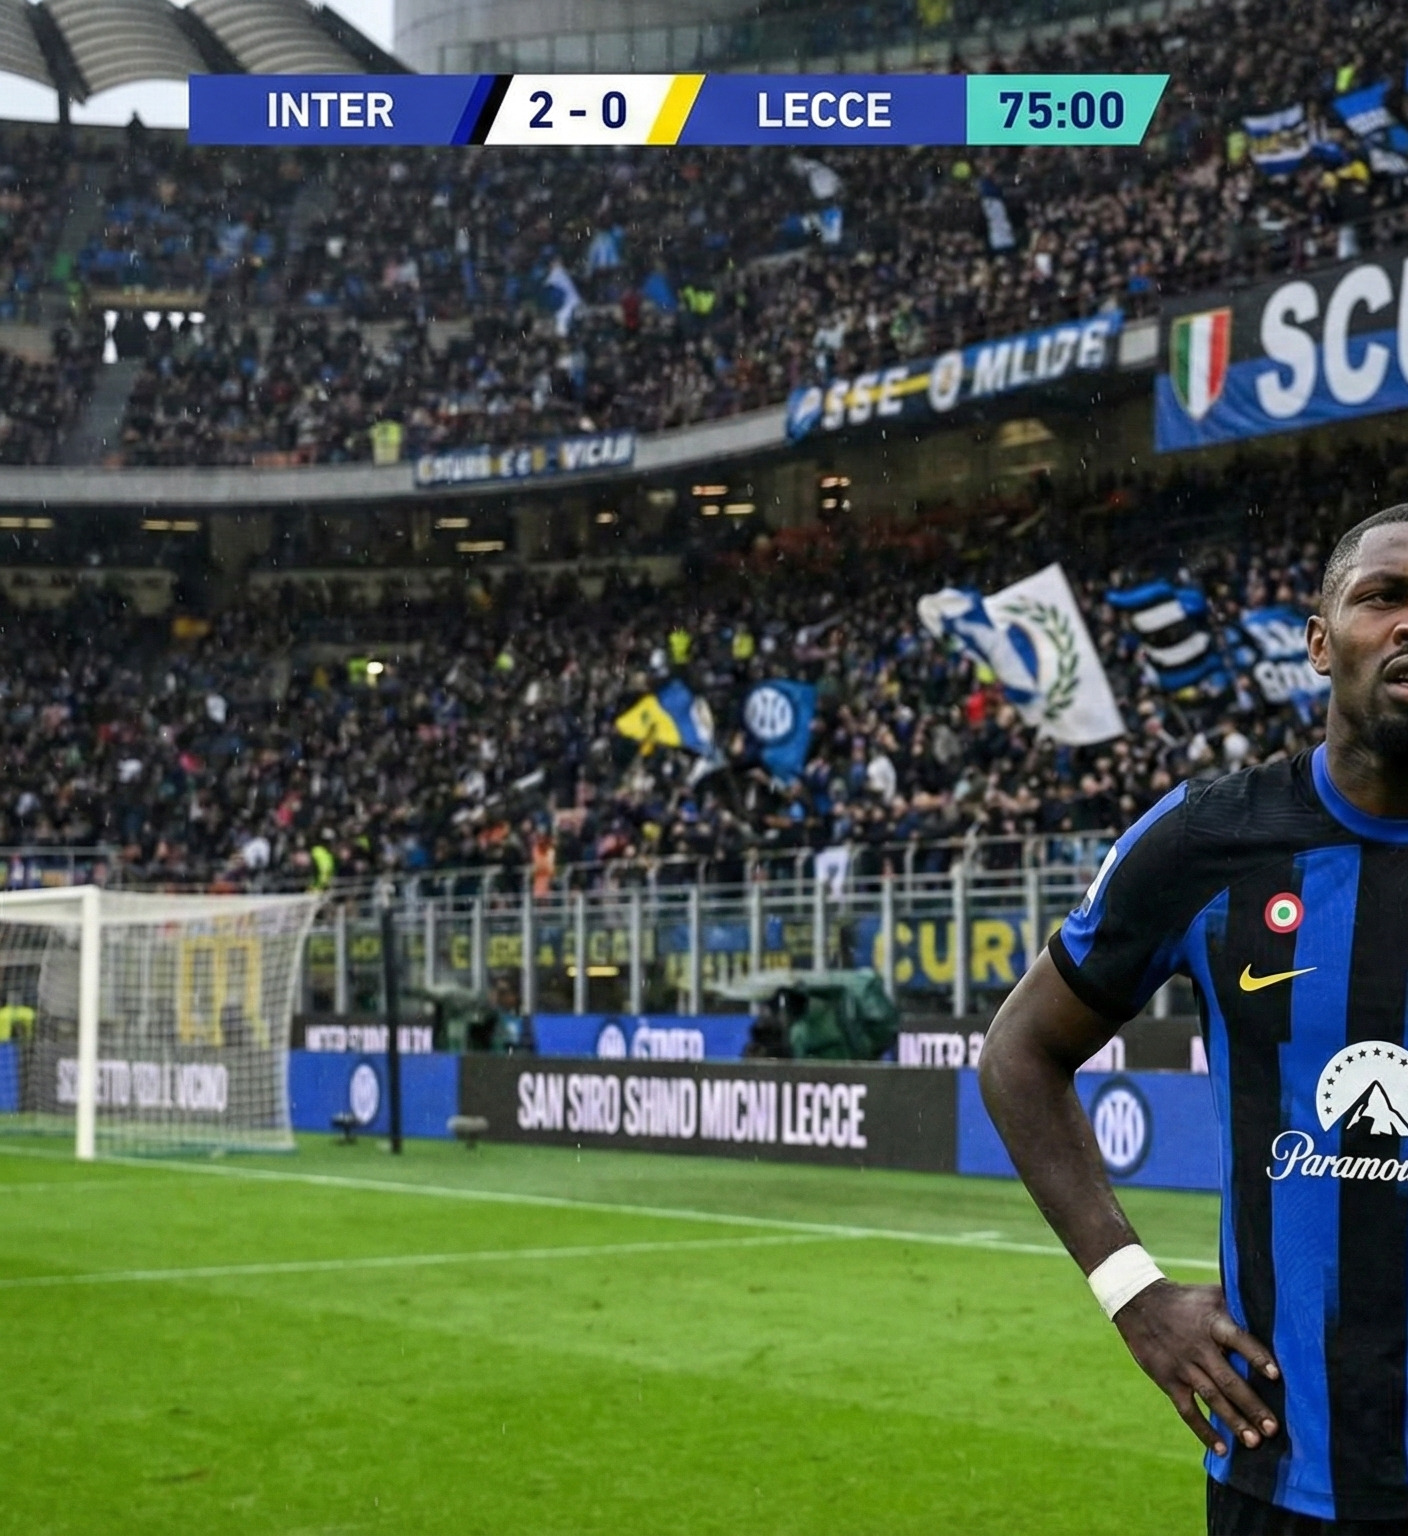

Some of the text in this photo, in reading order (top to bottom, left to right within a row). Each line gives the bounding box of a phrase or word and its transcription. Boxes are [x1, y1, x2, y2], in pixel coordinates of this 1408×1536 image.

[517, 1072, 564, 1131] SAN
[567, 1074, 620, 1135] SIRO
[782, 1082, 867, 1149] LECCE
